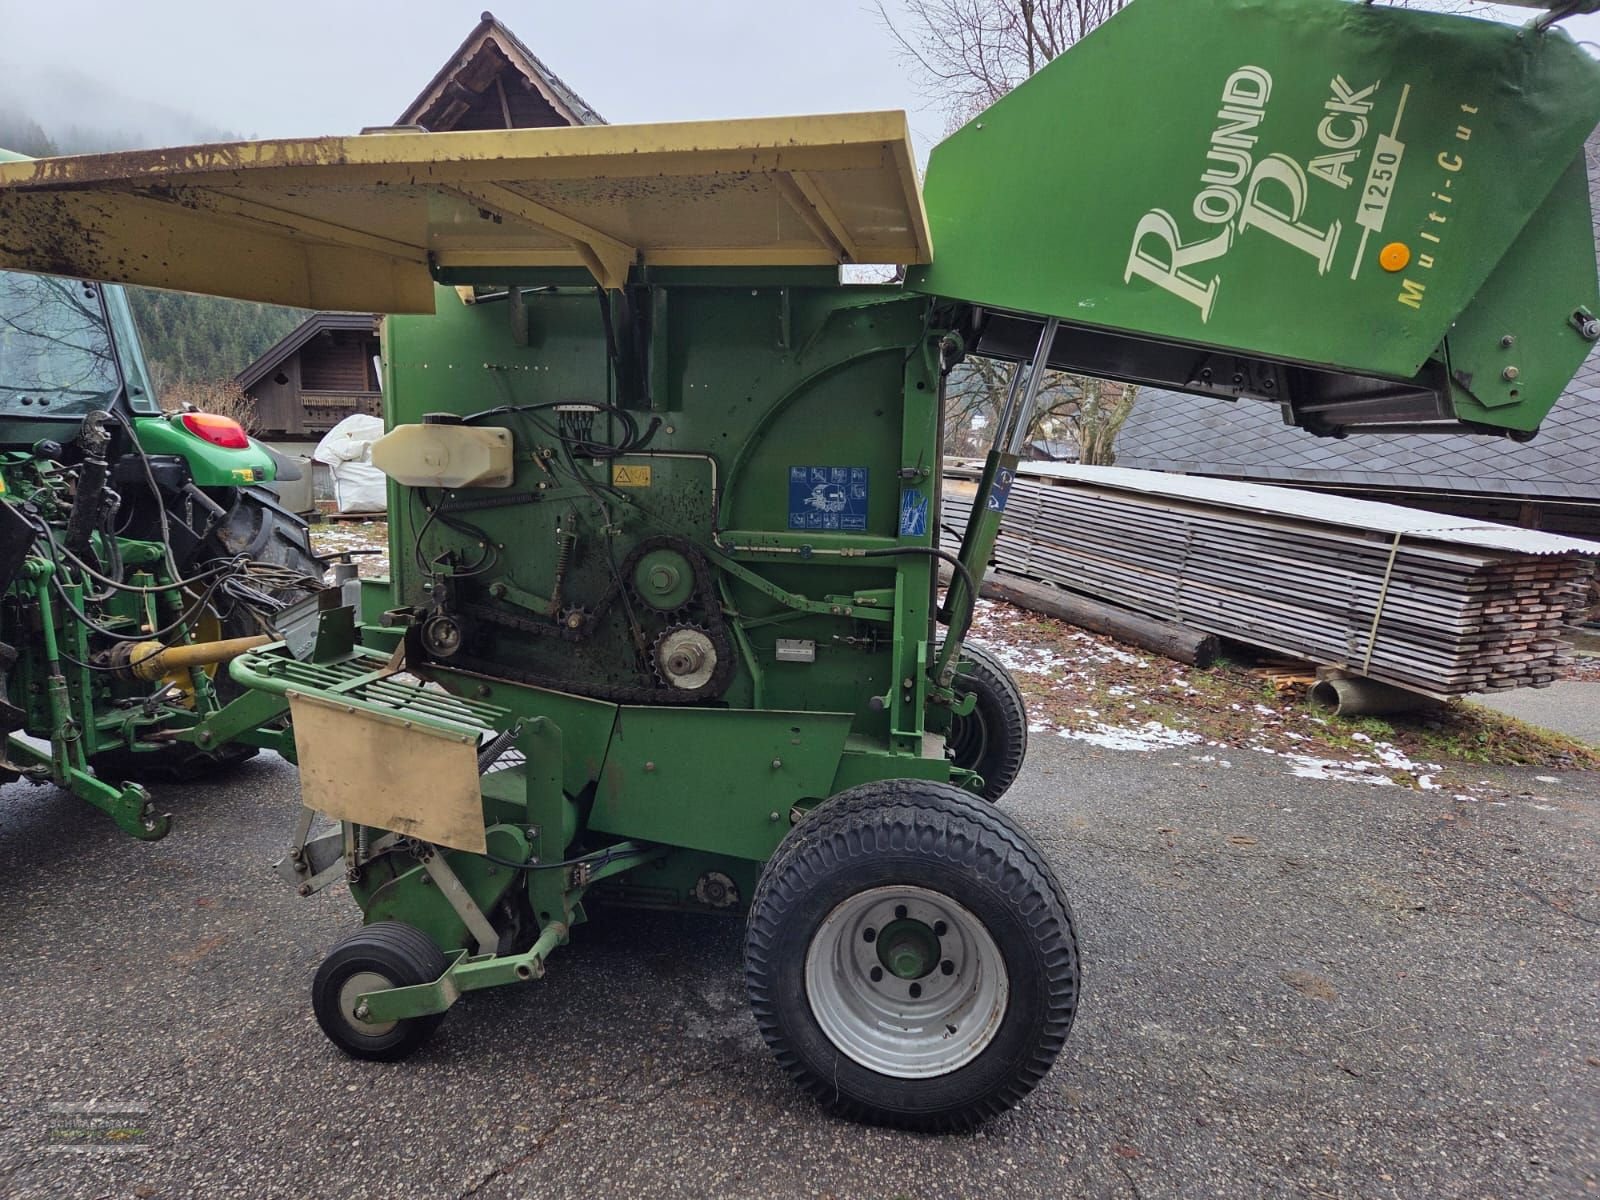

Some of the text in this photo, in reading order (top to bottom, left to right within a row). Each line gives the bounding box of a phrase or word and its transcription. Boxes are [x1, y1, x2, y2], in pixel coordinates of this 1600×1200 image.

[1124, 65, 1273, 324] ROUND
[1238, 73, 1381, 277] PACK
[1364, 152, 1398, 212] 1250
[1398, 103, 1479, 309] Multi-Cut
